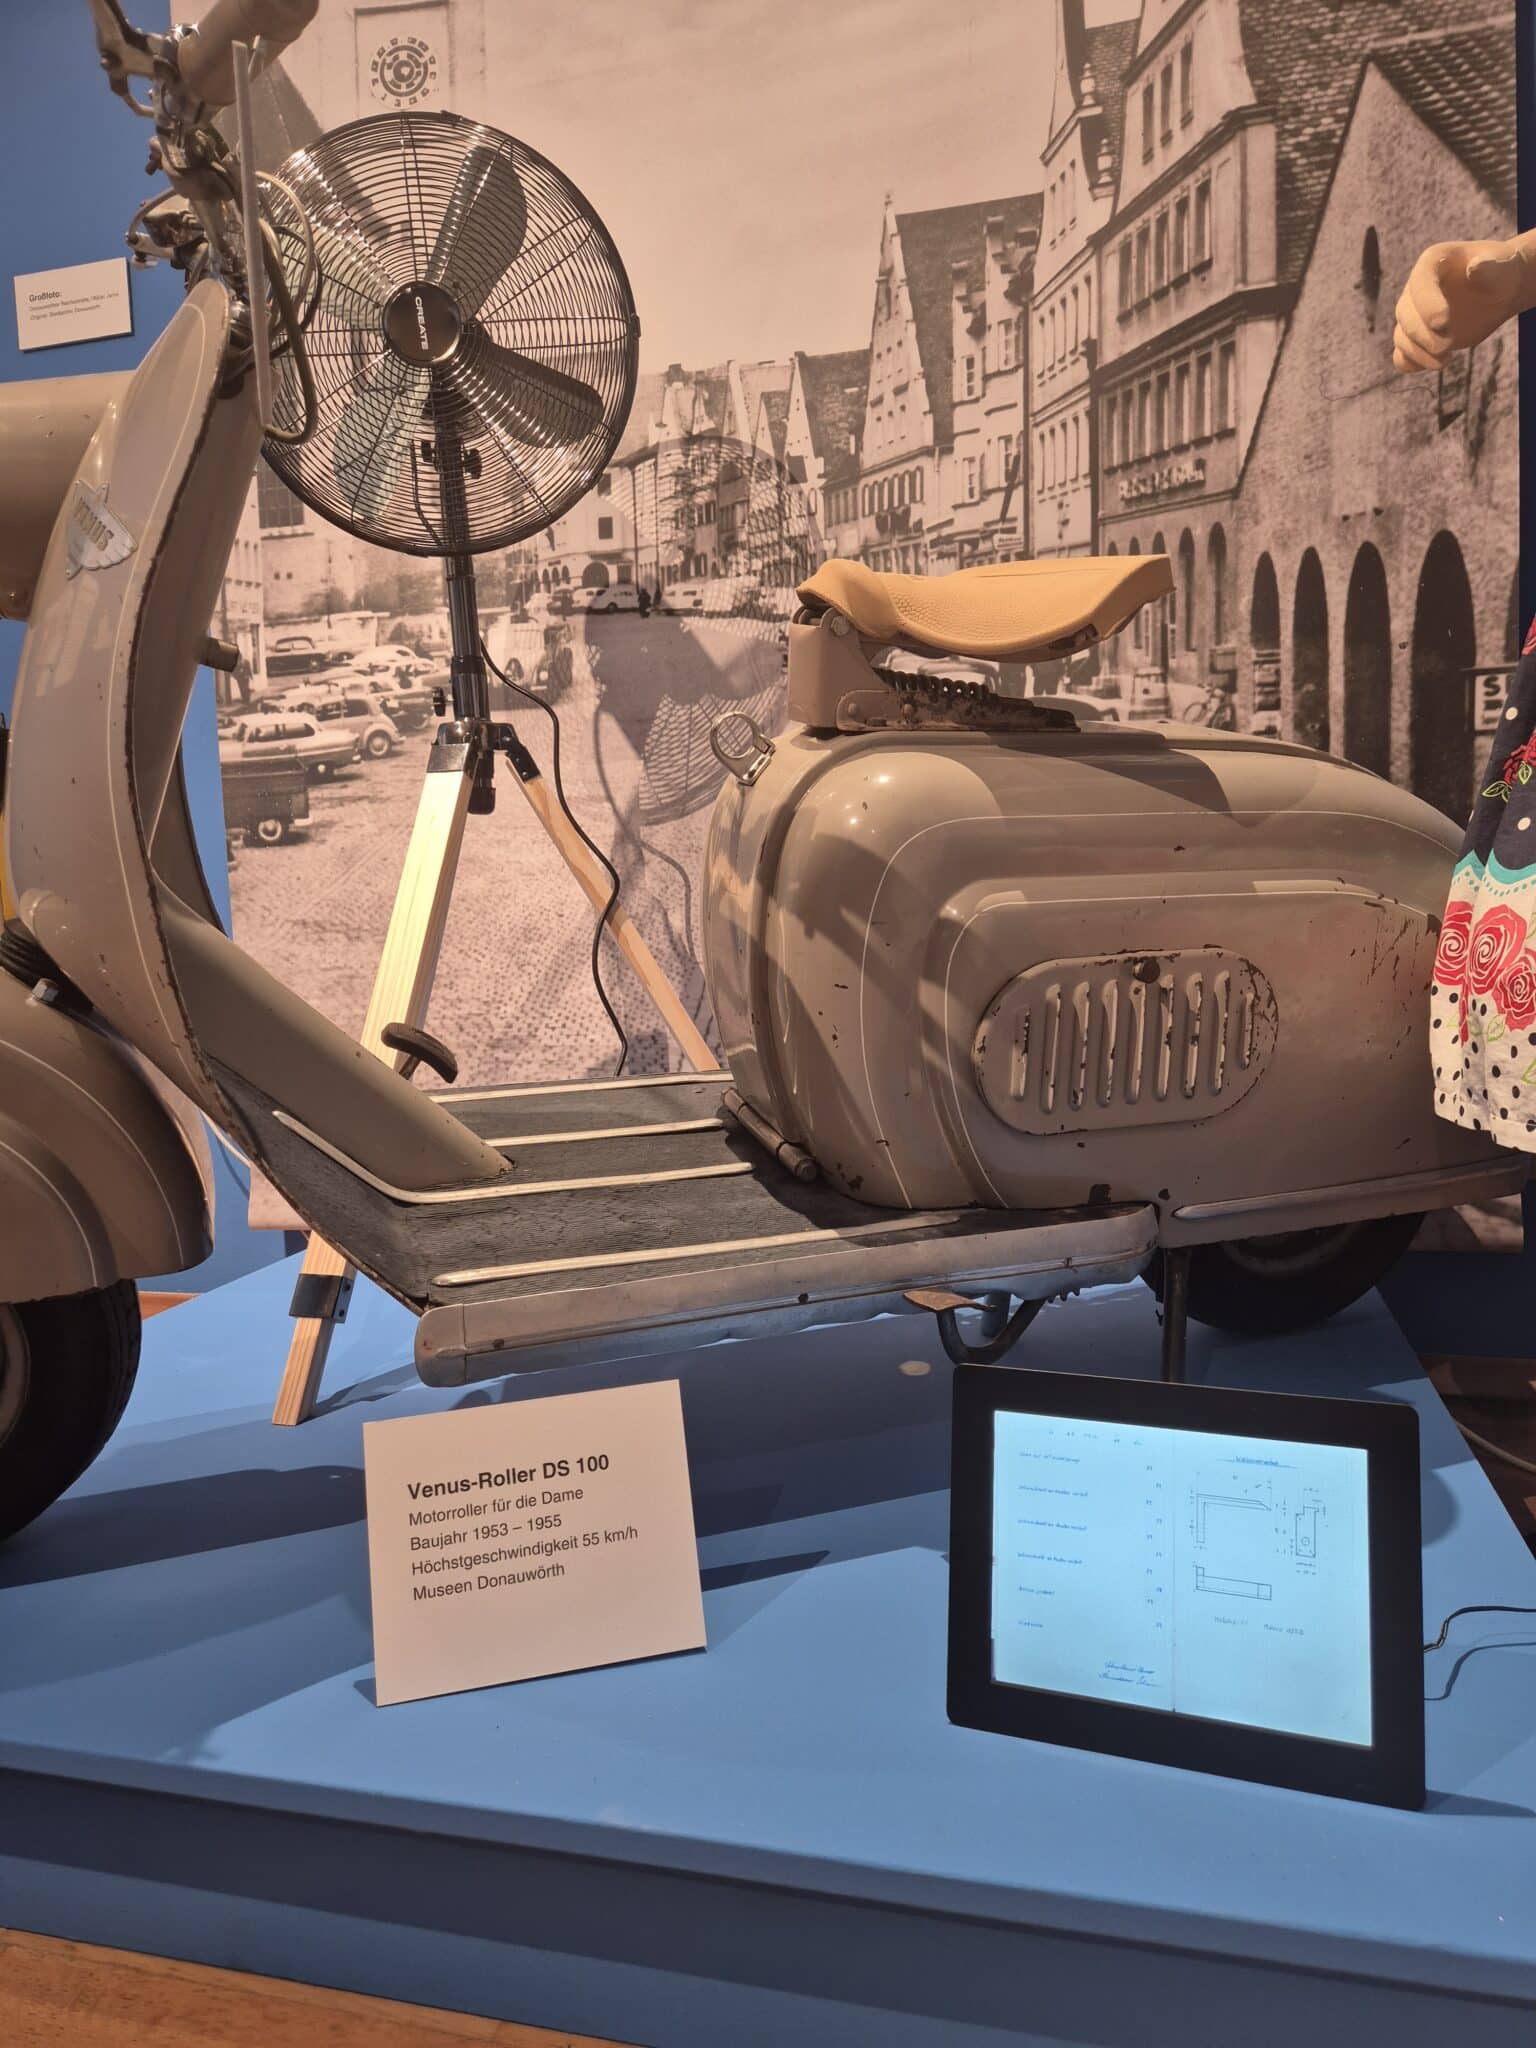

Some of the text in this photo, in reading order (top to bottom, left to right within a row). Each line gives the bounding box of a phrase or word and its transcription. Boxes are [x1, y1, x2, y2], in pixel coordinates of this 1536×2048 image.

[415, 295, 429, 351] CREATE
[406, 1453, 610, 1501] Venus-Roller DS 100
[408, 1488, 584, 1527] Motorroller für die Dame
[410, 1530, 468, 1552] Baujahr
[472, 1522, 509, 1542] 1953
[527, 1514, 563, 1532] 1955
[411, 1526, 639, 1576] Höchstgeschwindigkeit 55 km/h
[413, 1563, 566, 1601] Museen Donauwörth
